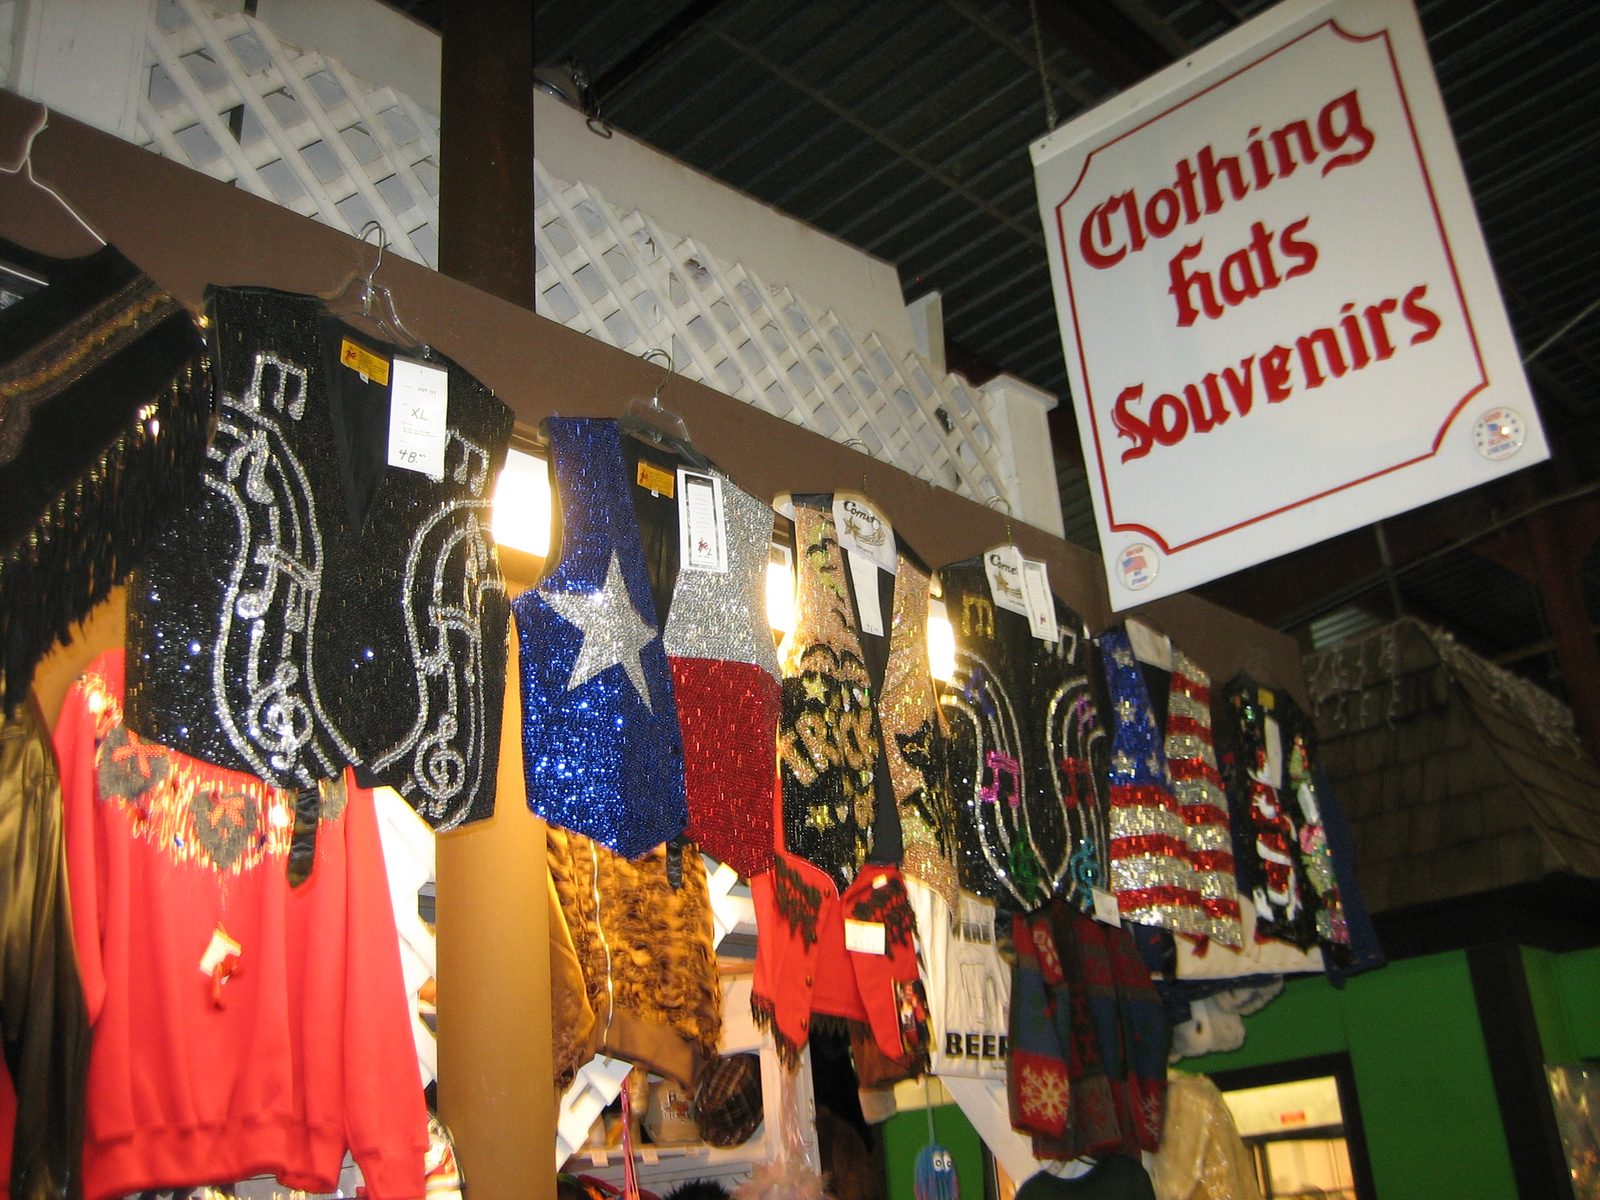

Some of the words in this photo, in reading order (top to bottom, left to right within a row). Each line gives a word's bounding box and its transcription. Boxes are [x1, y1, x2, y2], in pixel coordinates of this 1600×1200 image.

[1079, 89, 1375, 270] Clothing
[1111, 284, 1441, 464] Souvenirs
[411, 407, 428, 421] XL
[843, 500, 880, 526] Comet
[990, 554, 1018, 575] Come
